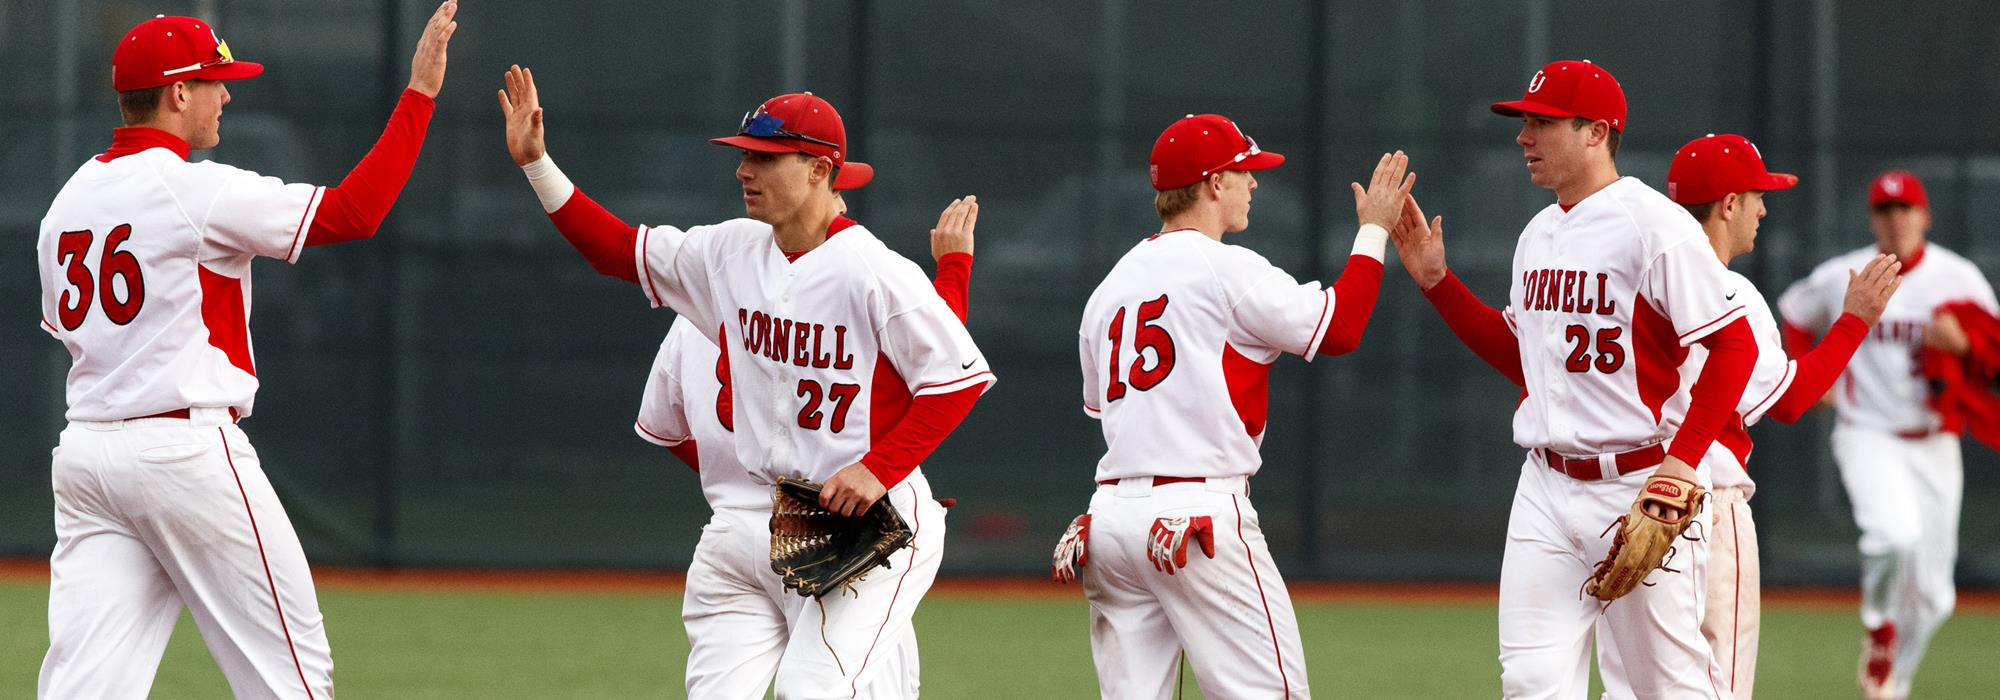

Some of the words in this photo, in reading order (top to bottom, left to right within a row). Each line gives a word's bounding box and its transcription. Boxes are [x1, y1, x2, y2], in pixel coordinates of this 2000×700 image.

[57, 223, 145, 332] 36
[738, 308, 854, 370] CORNELL
[1106, 293, 1176, 403] 15
[1565, 324, 1626, 375] 25
[796, 378, 861, 434] 27
